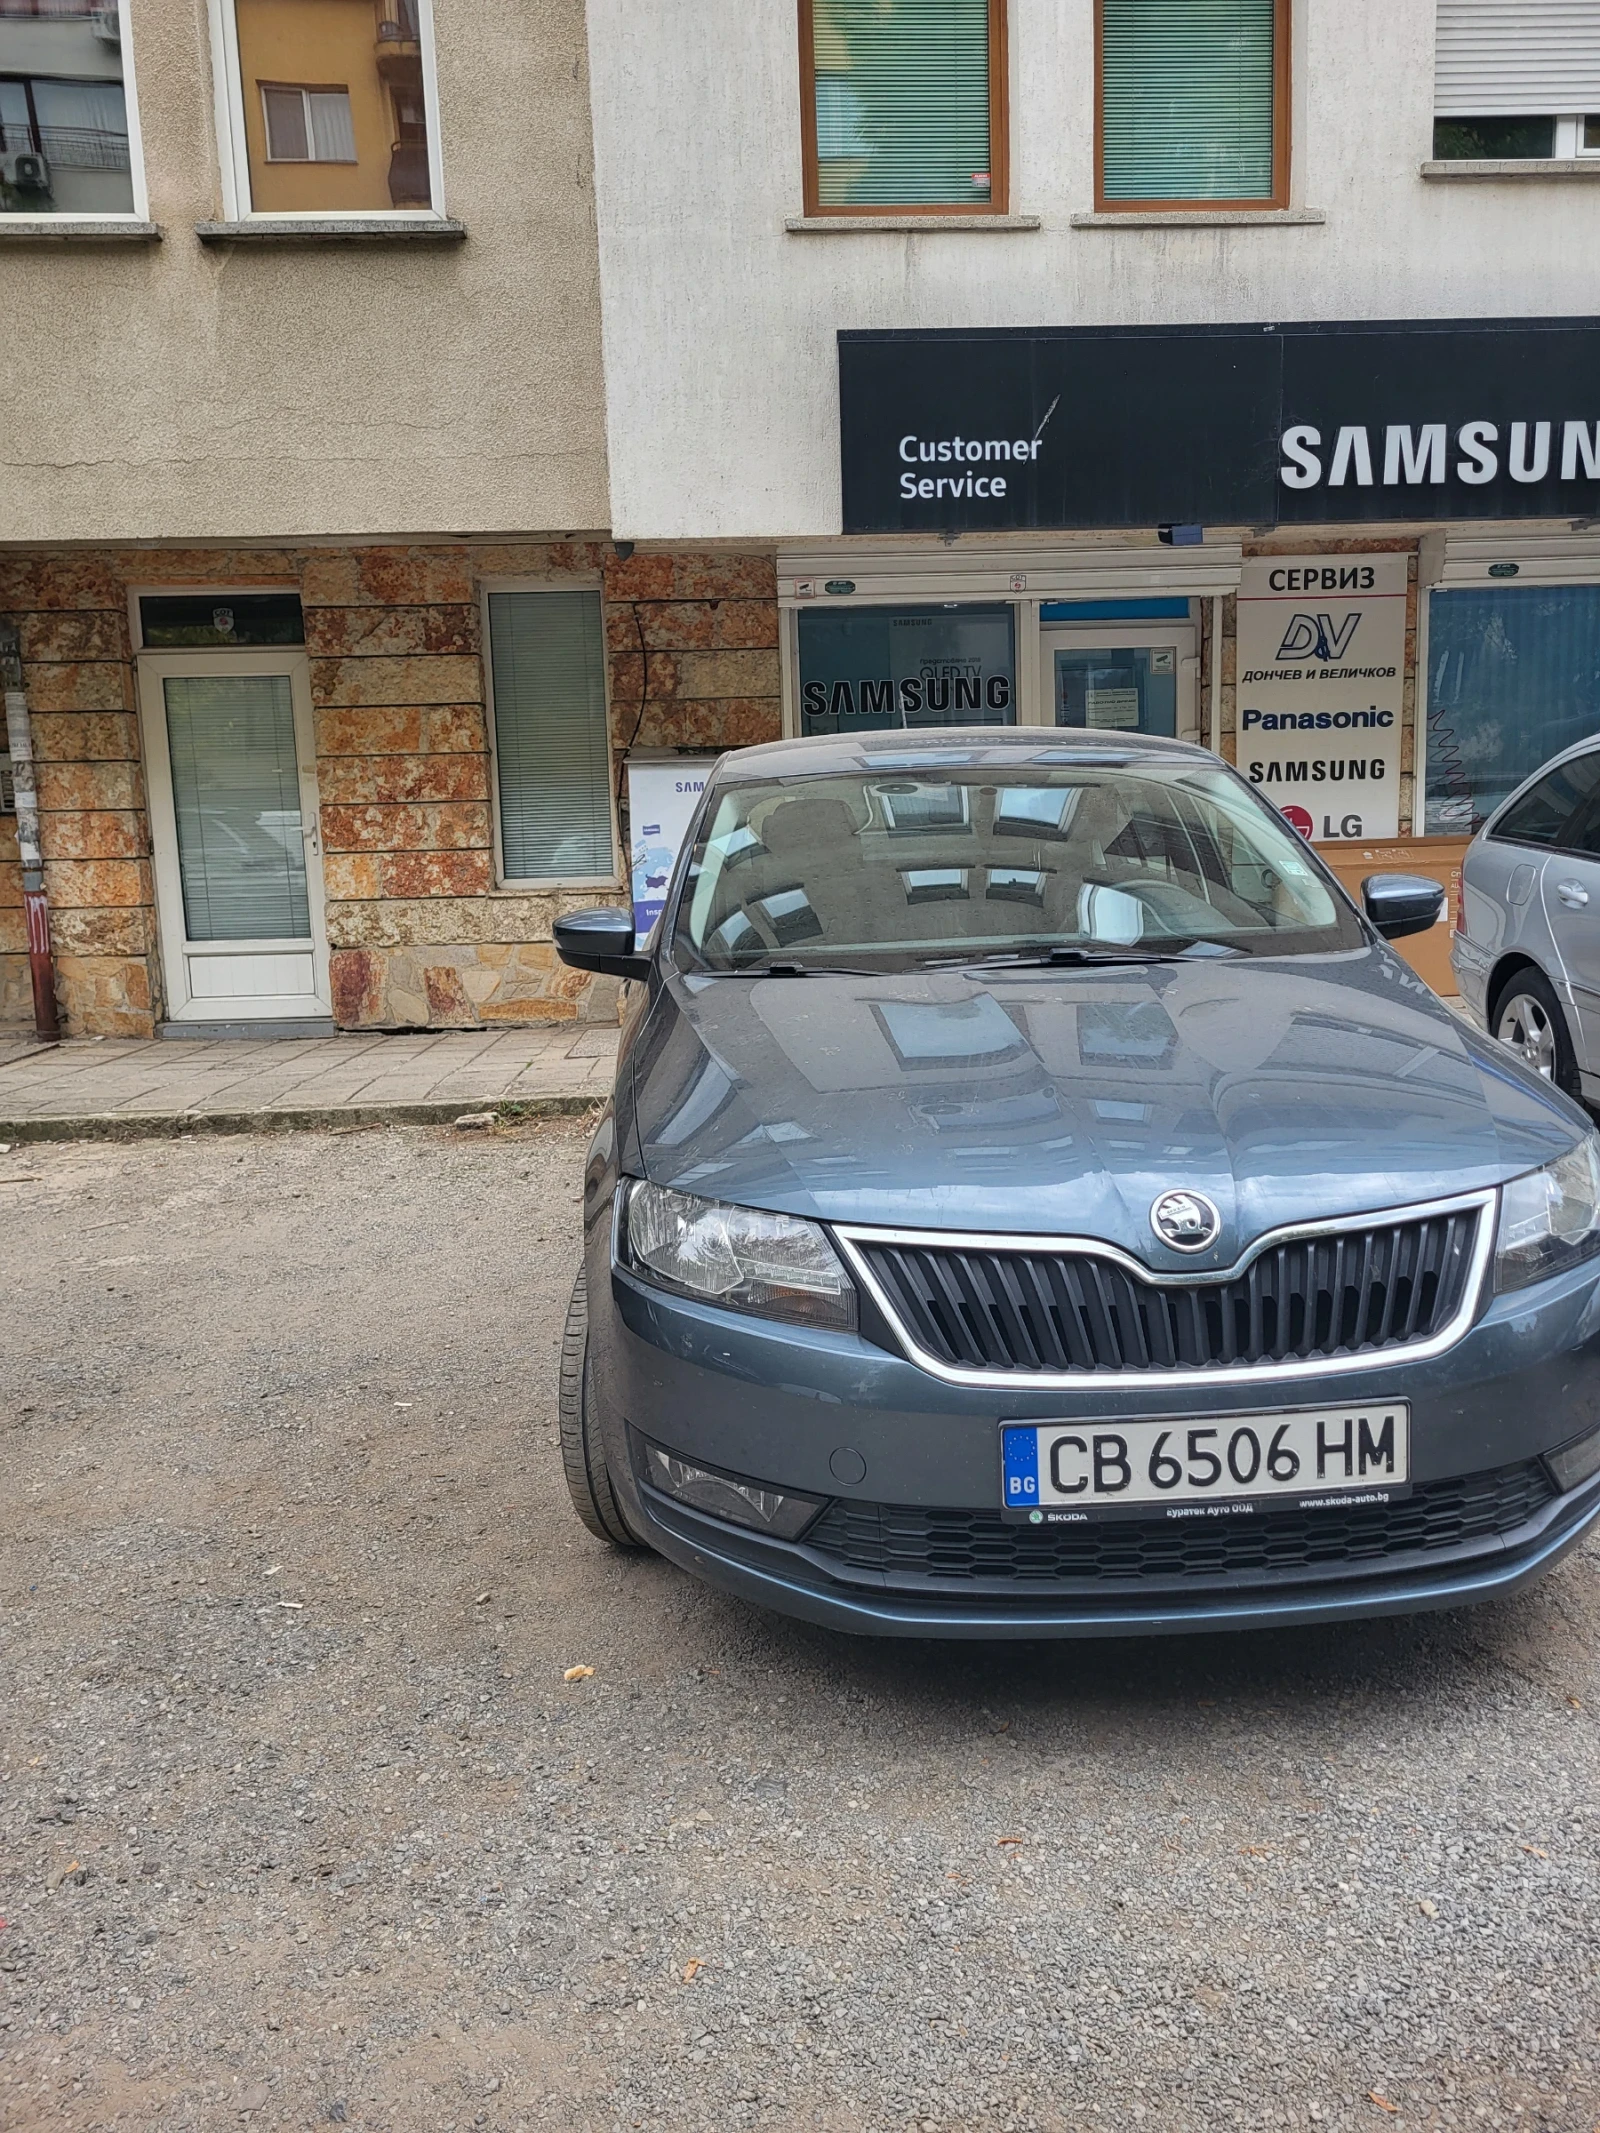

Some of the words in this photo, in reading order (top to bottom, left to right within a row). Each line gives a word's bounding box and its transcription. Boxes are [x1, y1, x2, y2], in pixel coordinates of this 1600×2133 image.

[899, 435, 1042, 464] Customer
[899, 471, 1007, 499] Service
[1268, 566, 1375, 592] СЕРВИЗ
[893, 619, 932, 627] SAMSUNG
[963, 665, 982, 677] TV
[1242, 669, 1302, 683] ДОНЧЕВ
[1305, 669, 1316, 680] И
[1319, 667, 1396, 680] ВЕЛИЧКОВ
[802, 674, 1010, 717] SAMSUNG
[1242, 705, 1395, 731] Panasonic
[1249, 758, 1386, 784] SAMSUNG
[1323, 814, 1363, 838] LG
[1049, 1433, 1132, 1494] CB
[1147, 1423, 1300, 1489] 6506
[1315, 1415, 1395, 1480] HM
[1009, 1476, 1035, 1495] BG
[1231, 1502, 1254, 1513] ООД
[1299, 1491, 1389, 1508] www.skoda-auto.bg
